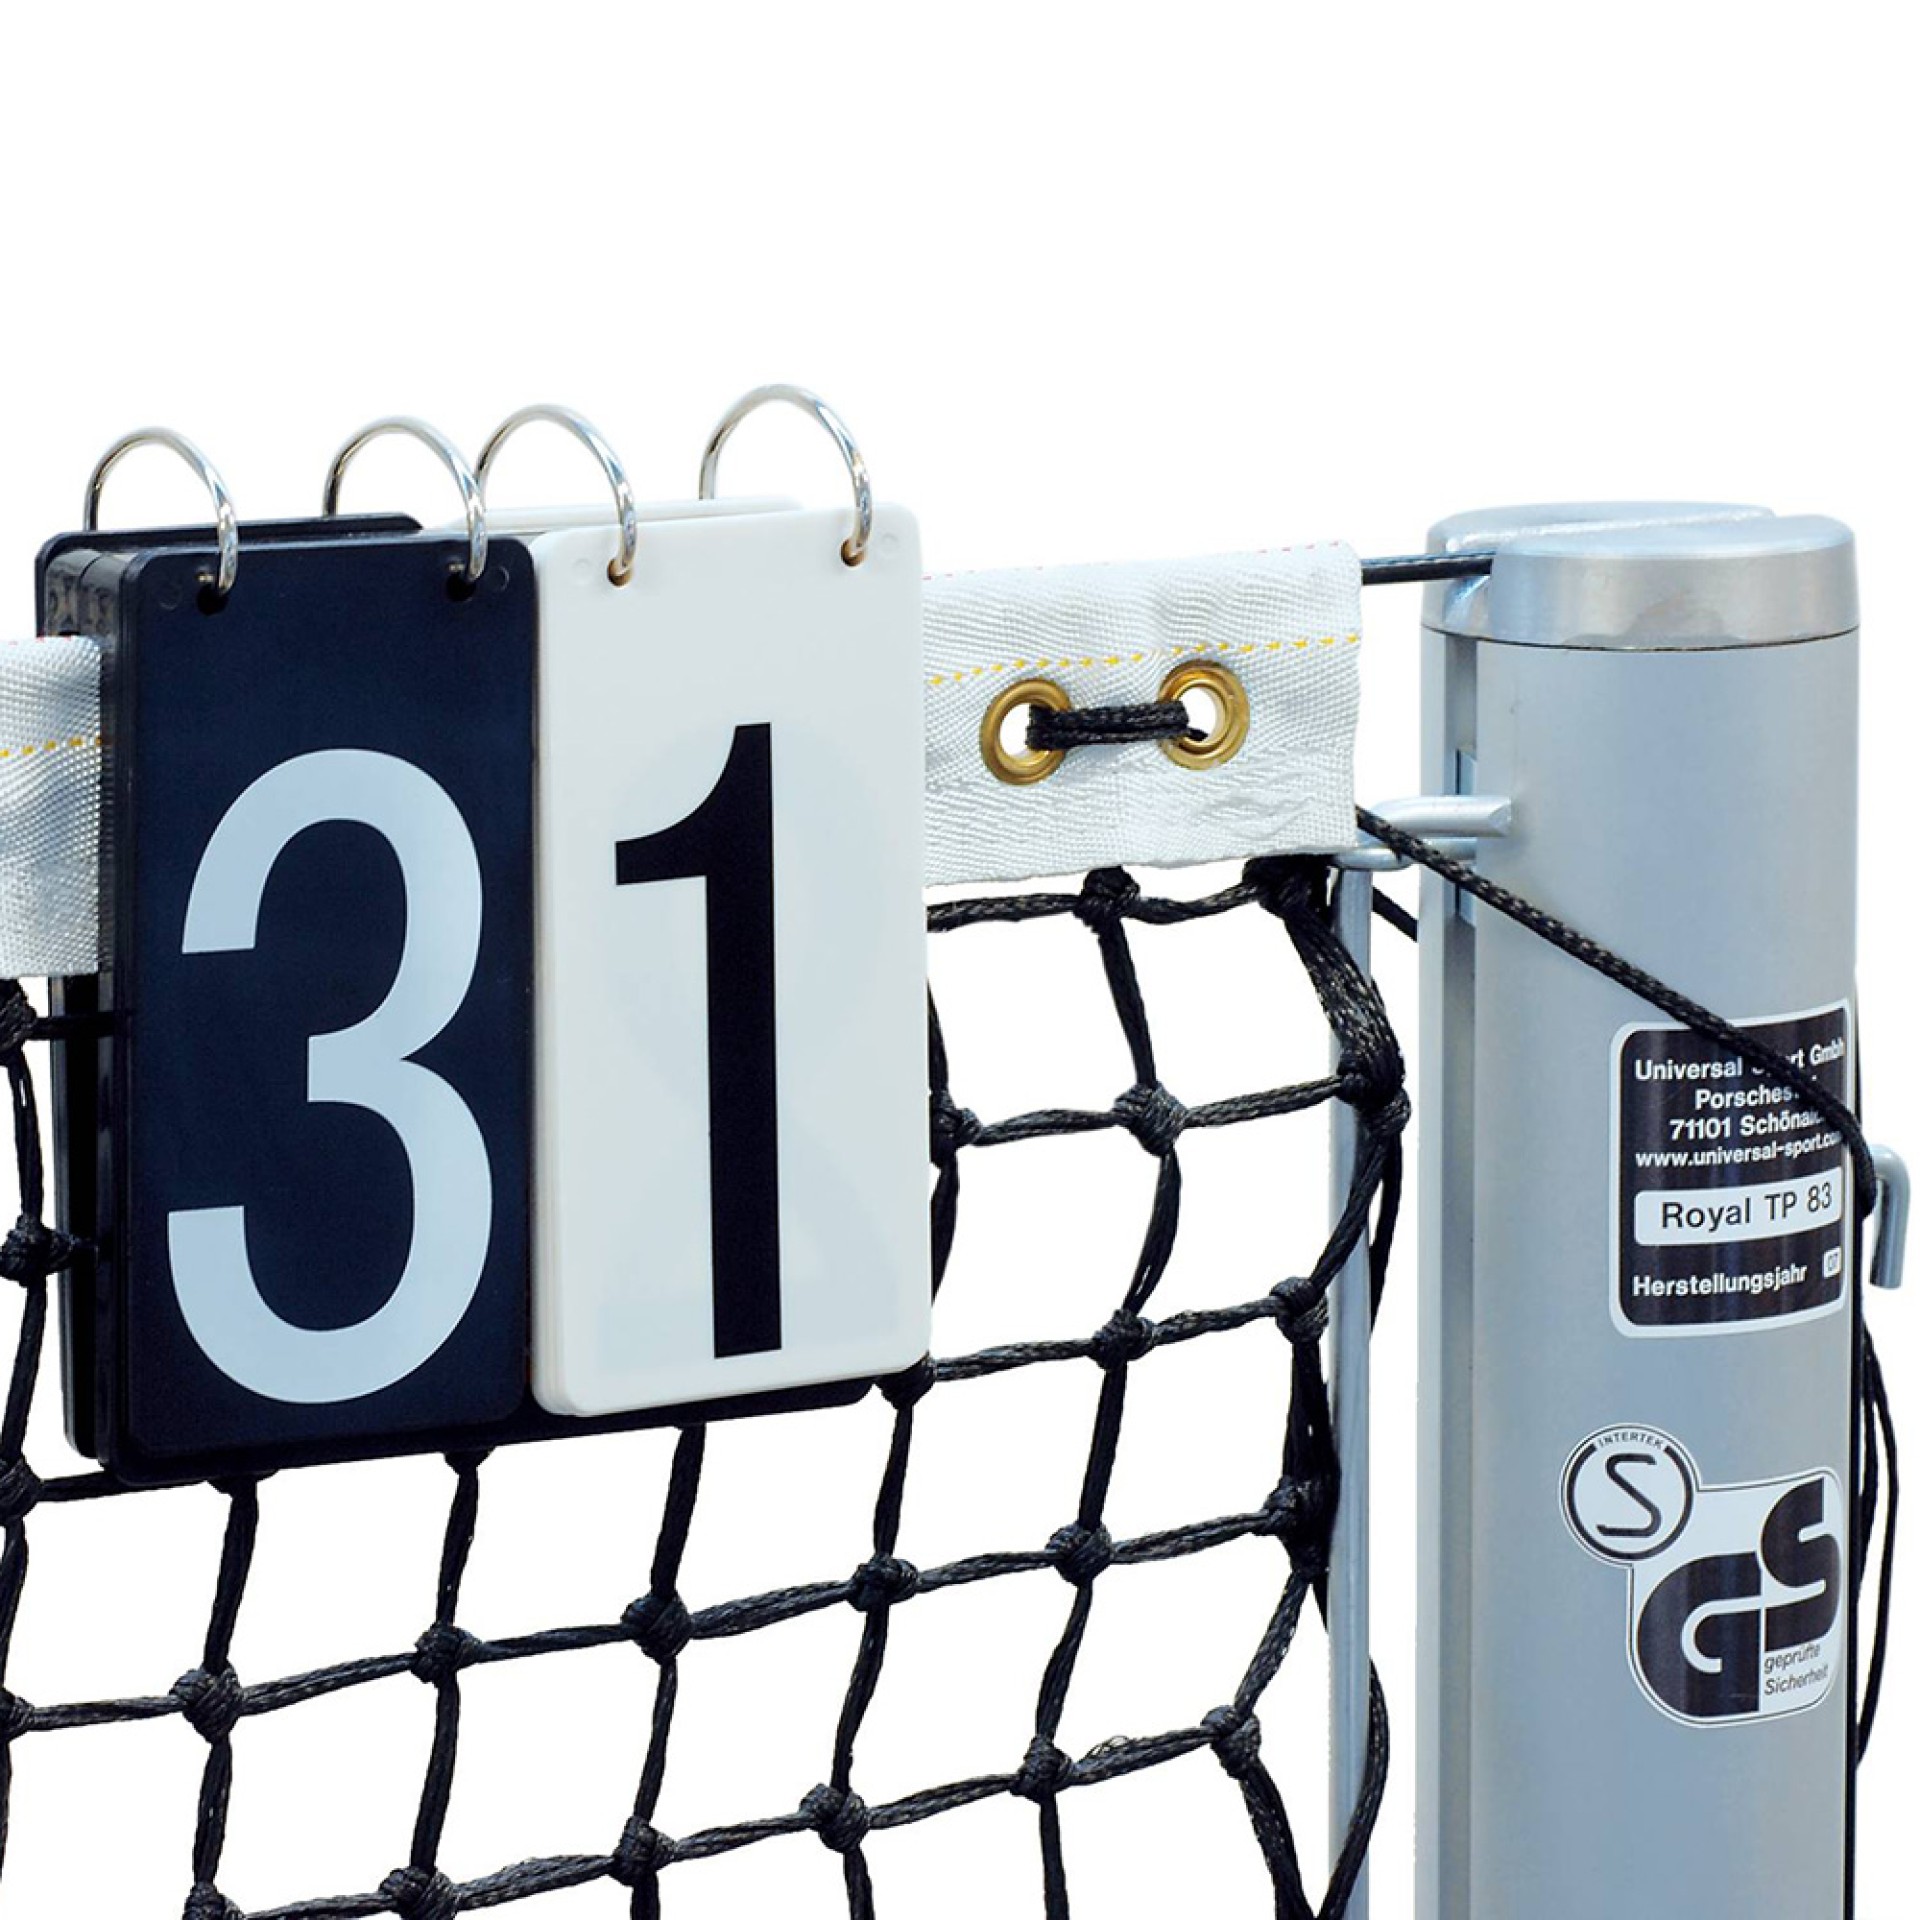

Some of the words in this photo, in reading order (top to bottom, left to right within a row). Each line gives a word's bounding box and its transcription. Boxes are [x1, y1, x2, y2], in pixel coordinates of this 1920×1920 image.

[615, 722, 781, 1358] 1
[168, 748, 493, 1404] 3
[1635, 1057, 1743, 1080] Universal
[1695, 1084, 1799, 1110] Porsches
[1669, 1117, 1732, 1141] 71101
[1662, 1197, 1751, 1232] Royal
[1764, 1191, 1797, 1220] TP
[1806, 1181, 1832, 1213] 83
[1632, 1263, 1808, 1296] Herstellungsjahr
[1598, 1432, 1664, 1449] INTERTEK
[1764, 1642, 1821, 1674] geprüfte
[1764, 1664, 1829, 1696] Sicherheit
